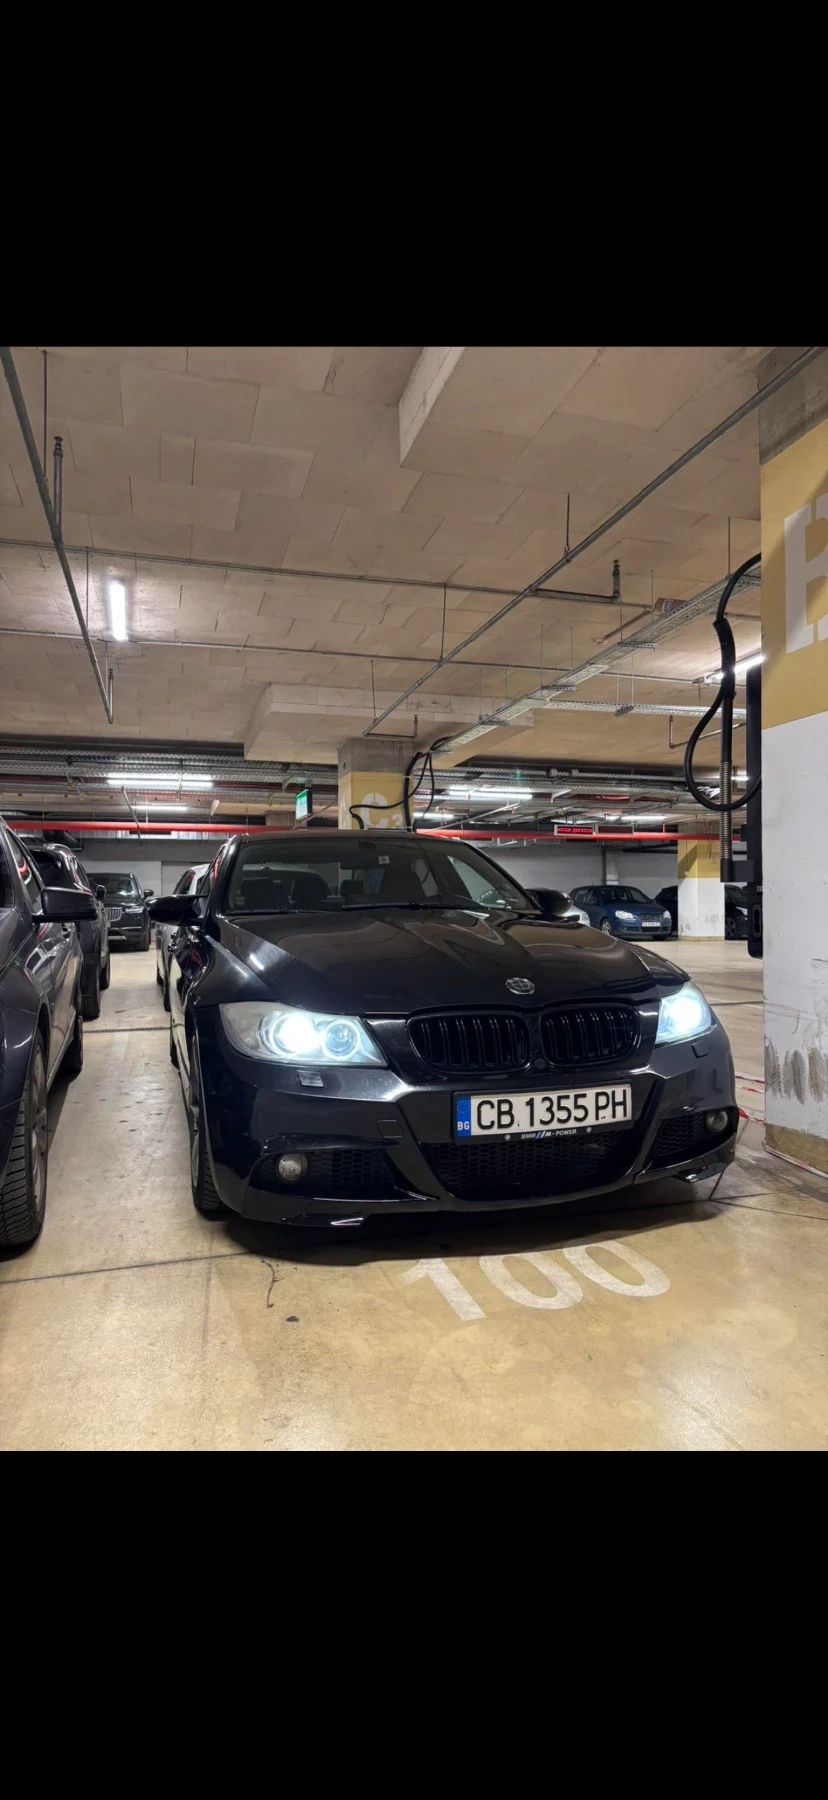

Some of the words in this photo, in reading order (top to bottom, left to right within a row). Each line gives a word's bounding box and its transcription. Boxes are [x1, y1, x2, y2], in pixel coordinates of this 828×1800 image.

[457, 1121, 470, 1131] BG
[477, 1099, 515, 1130] CB
[525, 1093, 589, 1127] 1355
[595, 1089, 627, 1121] PH
[397, 1239, 671, 1322] 100
